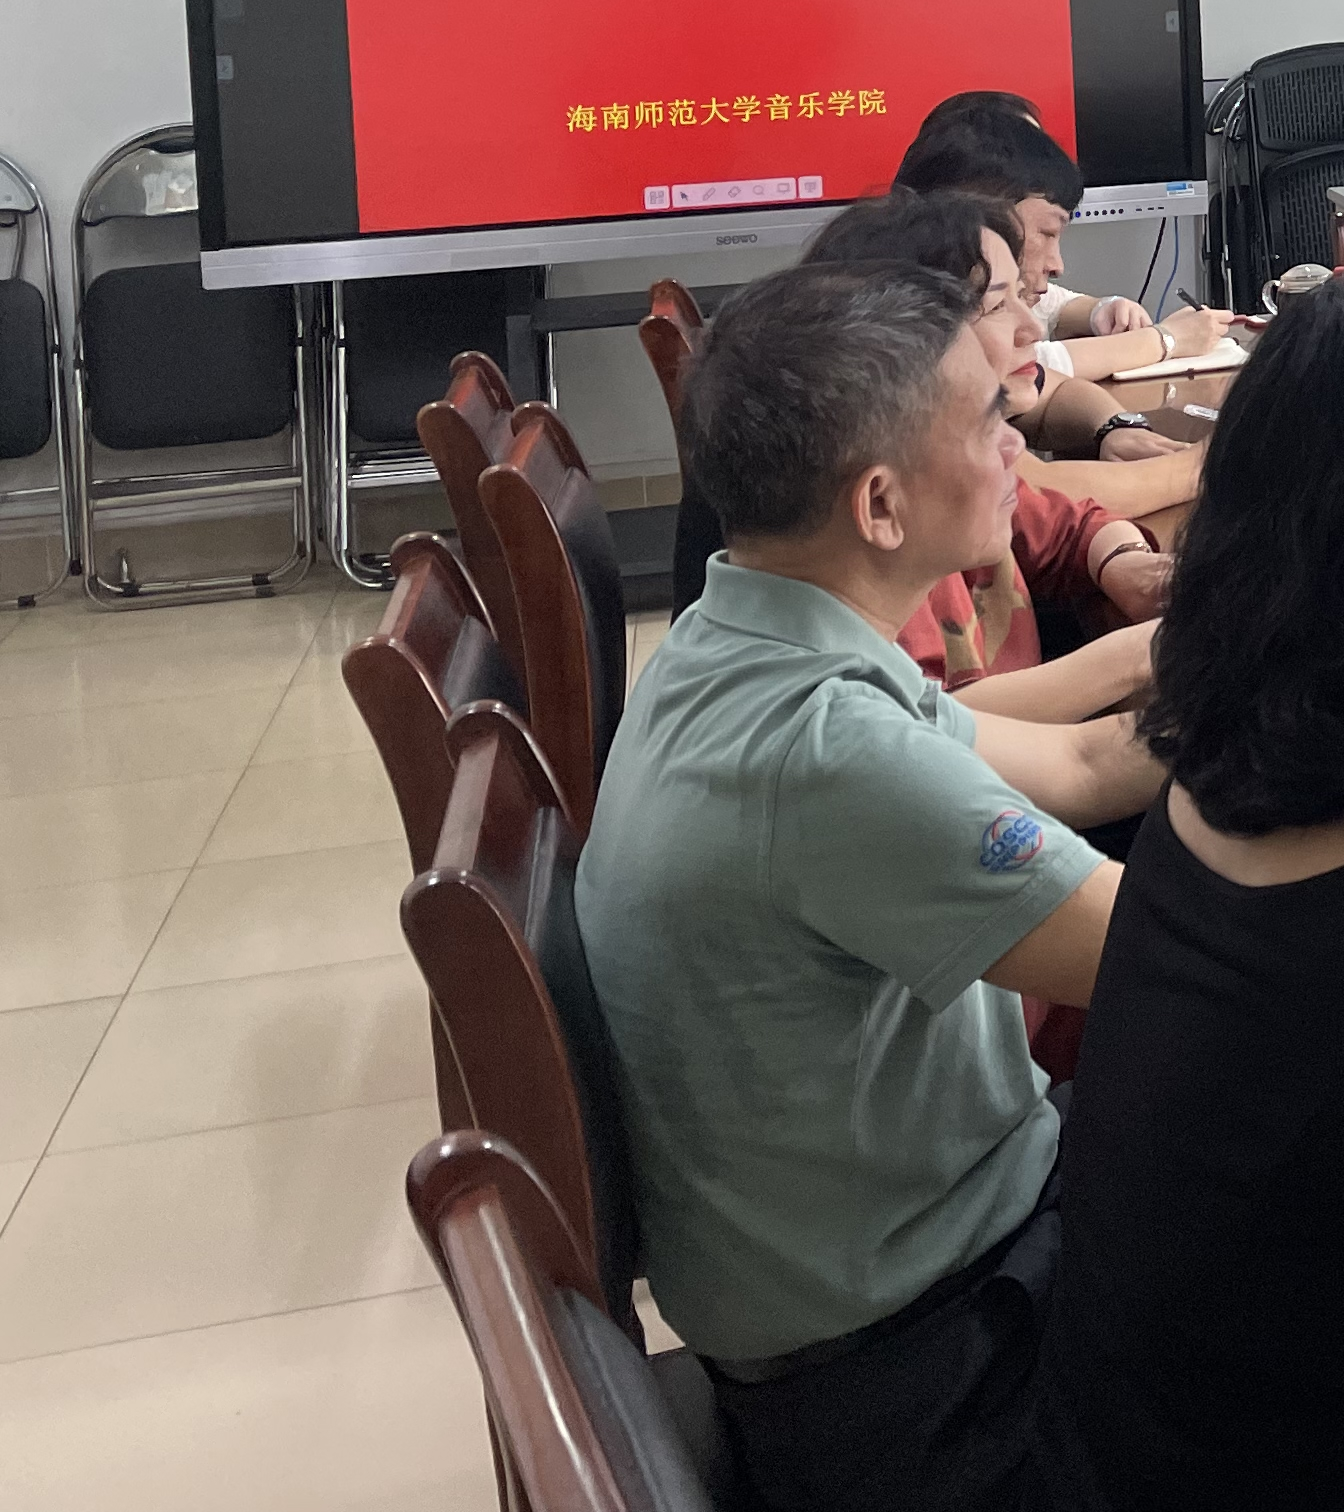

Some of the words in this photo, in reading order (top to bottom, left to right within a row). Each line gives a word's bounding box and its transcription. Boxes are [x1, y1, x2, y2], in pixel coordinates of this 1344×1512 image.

[565, 87, 887, 134] 海南师范大学音乐学院
[715, 233, 758, 246] seewo
